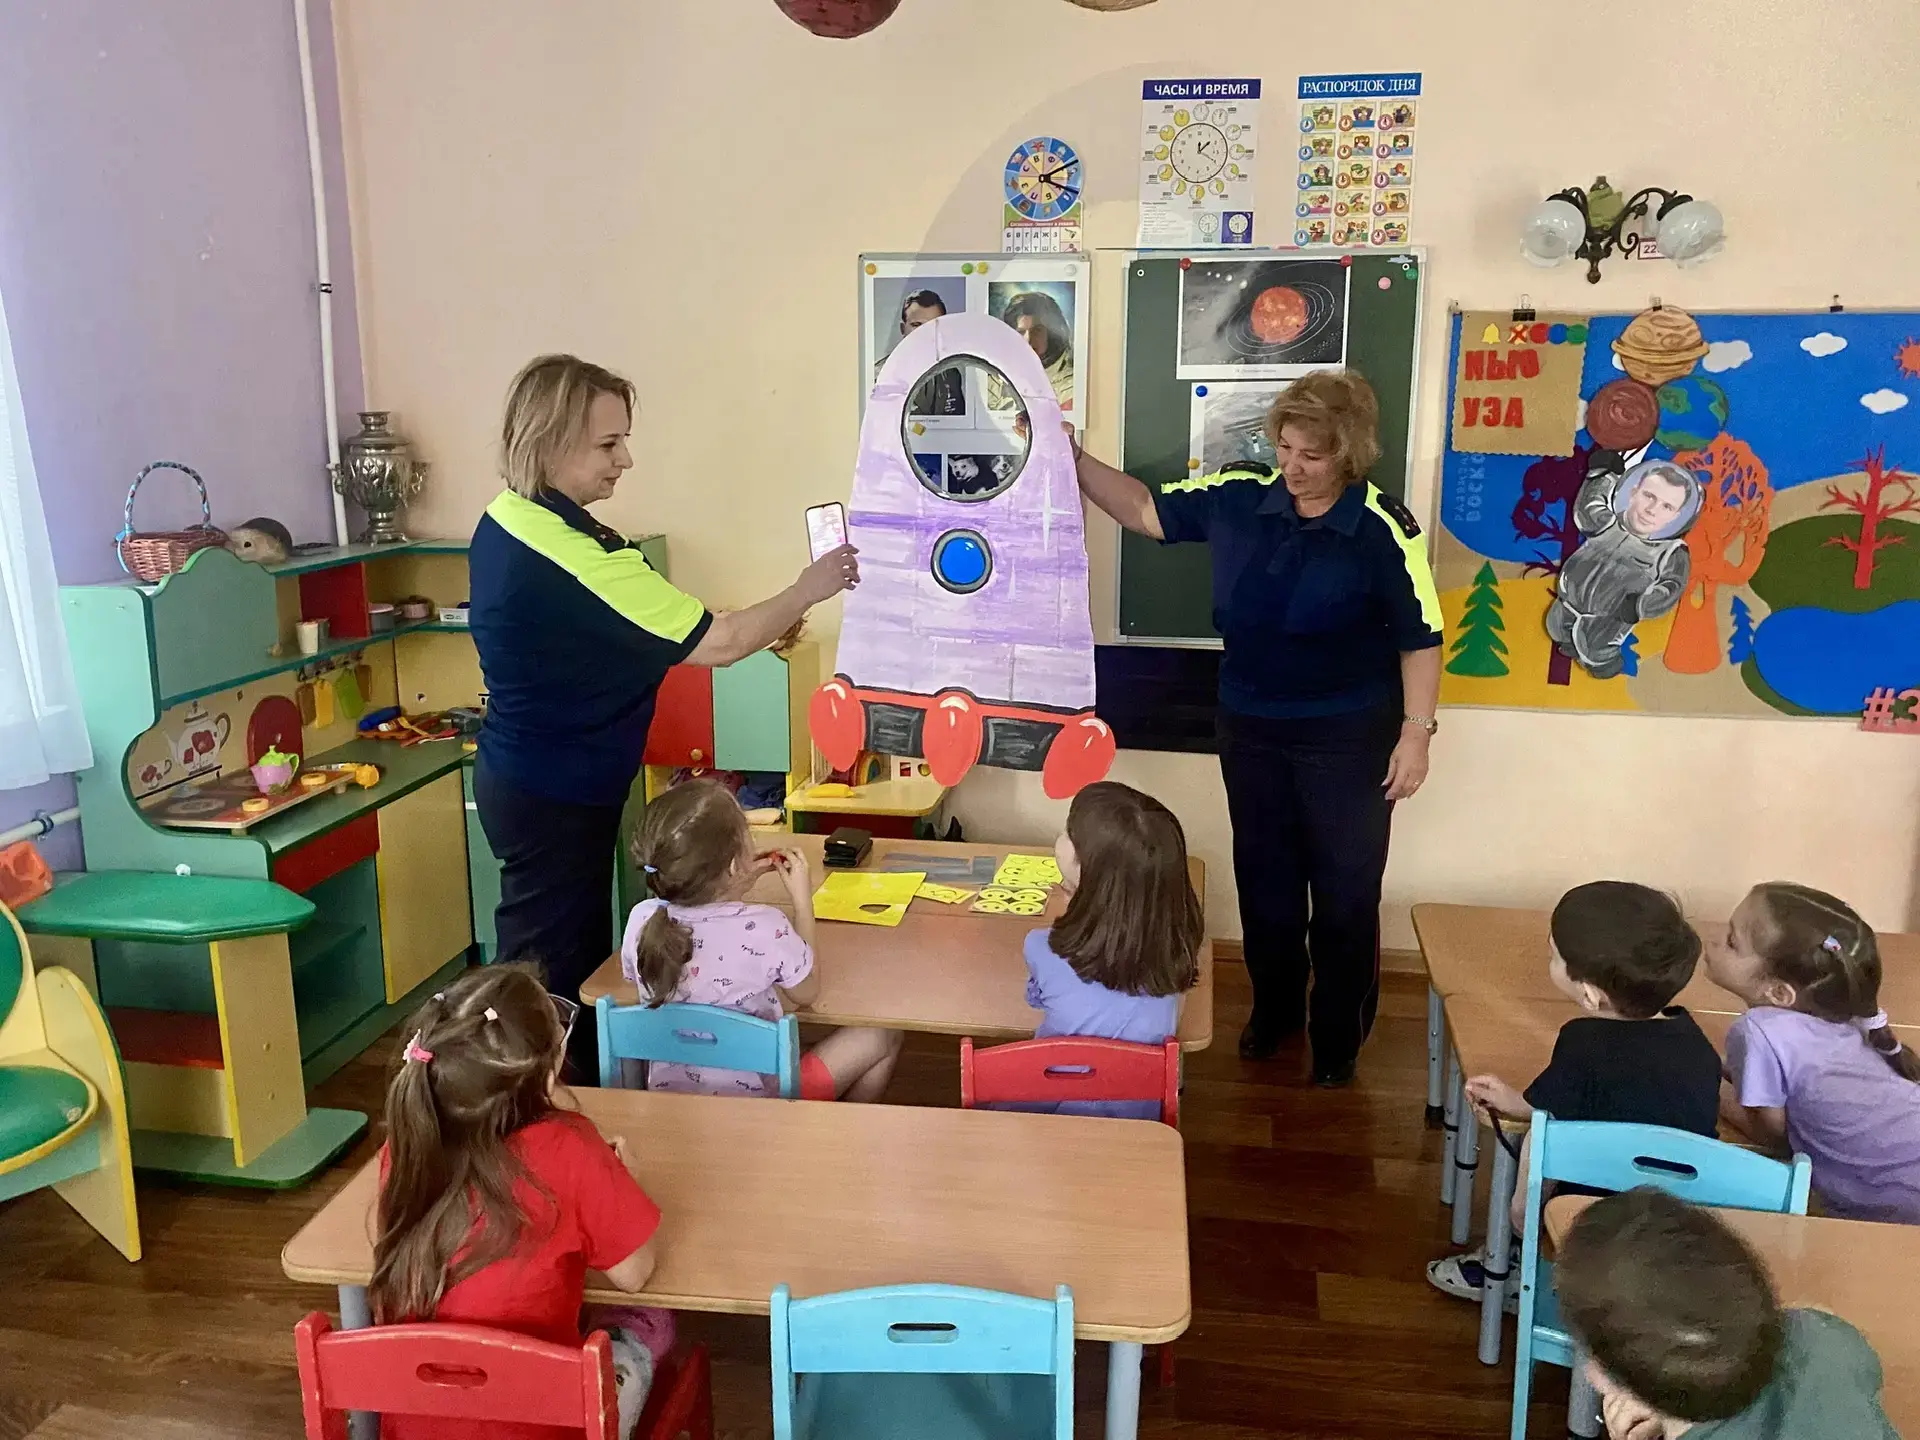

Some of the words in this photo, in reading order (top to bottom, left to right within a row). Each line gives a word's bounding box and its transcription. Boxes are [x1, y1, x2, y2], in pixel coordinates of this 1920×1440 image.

[1154, 84, 1189, 96] ЧАСЫ
[1193, 84, 1202, 95] И
[1205, 83, 1249, 95] ВРЕМЯ
[1303, 80, 1385, 94] РАСПОРЯДОК
[1388, 78, 1417, 92] ДНЯ
[1463, 396, 1524, 428] УЗА
